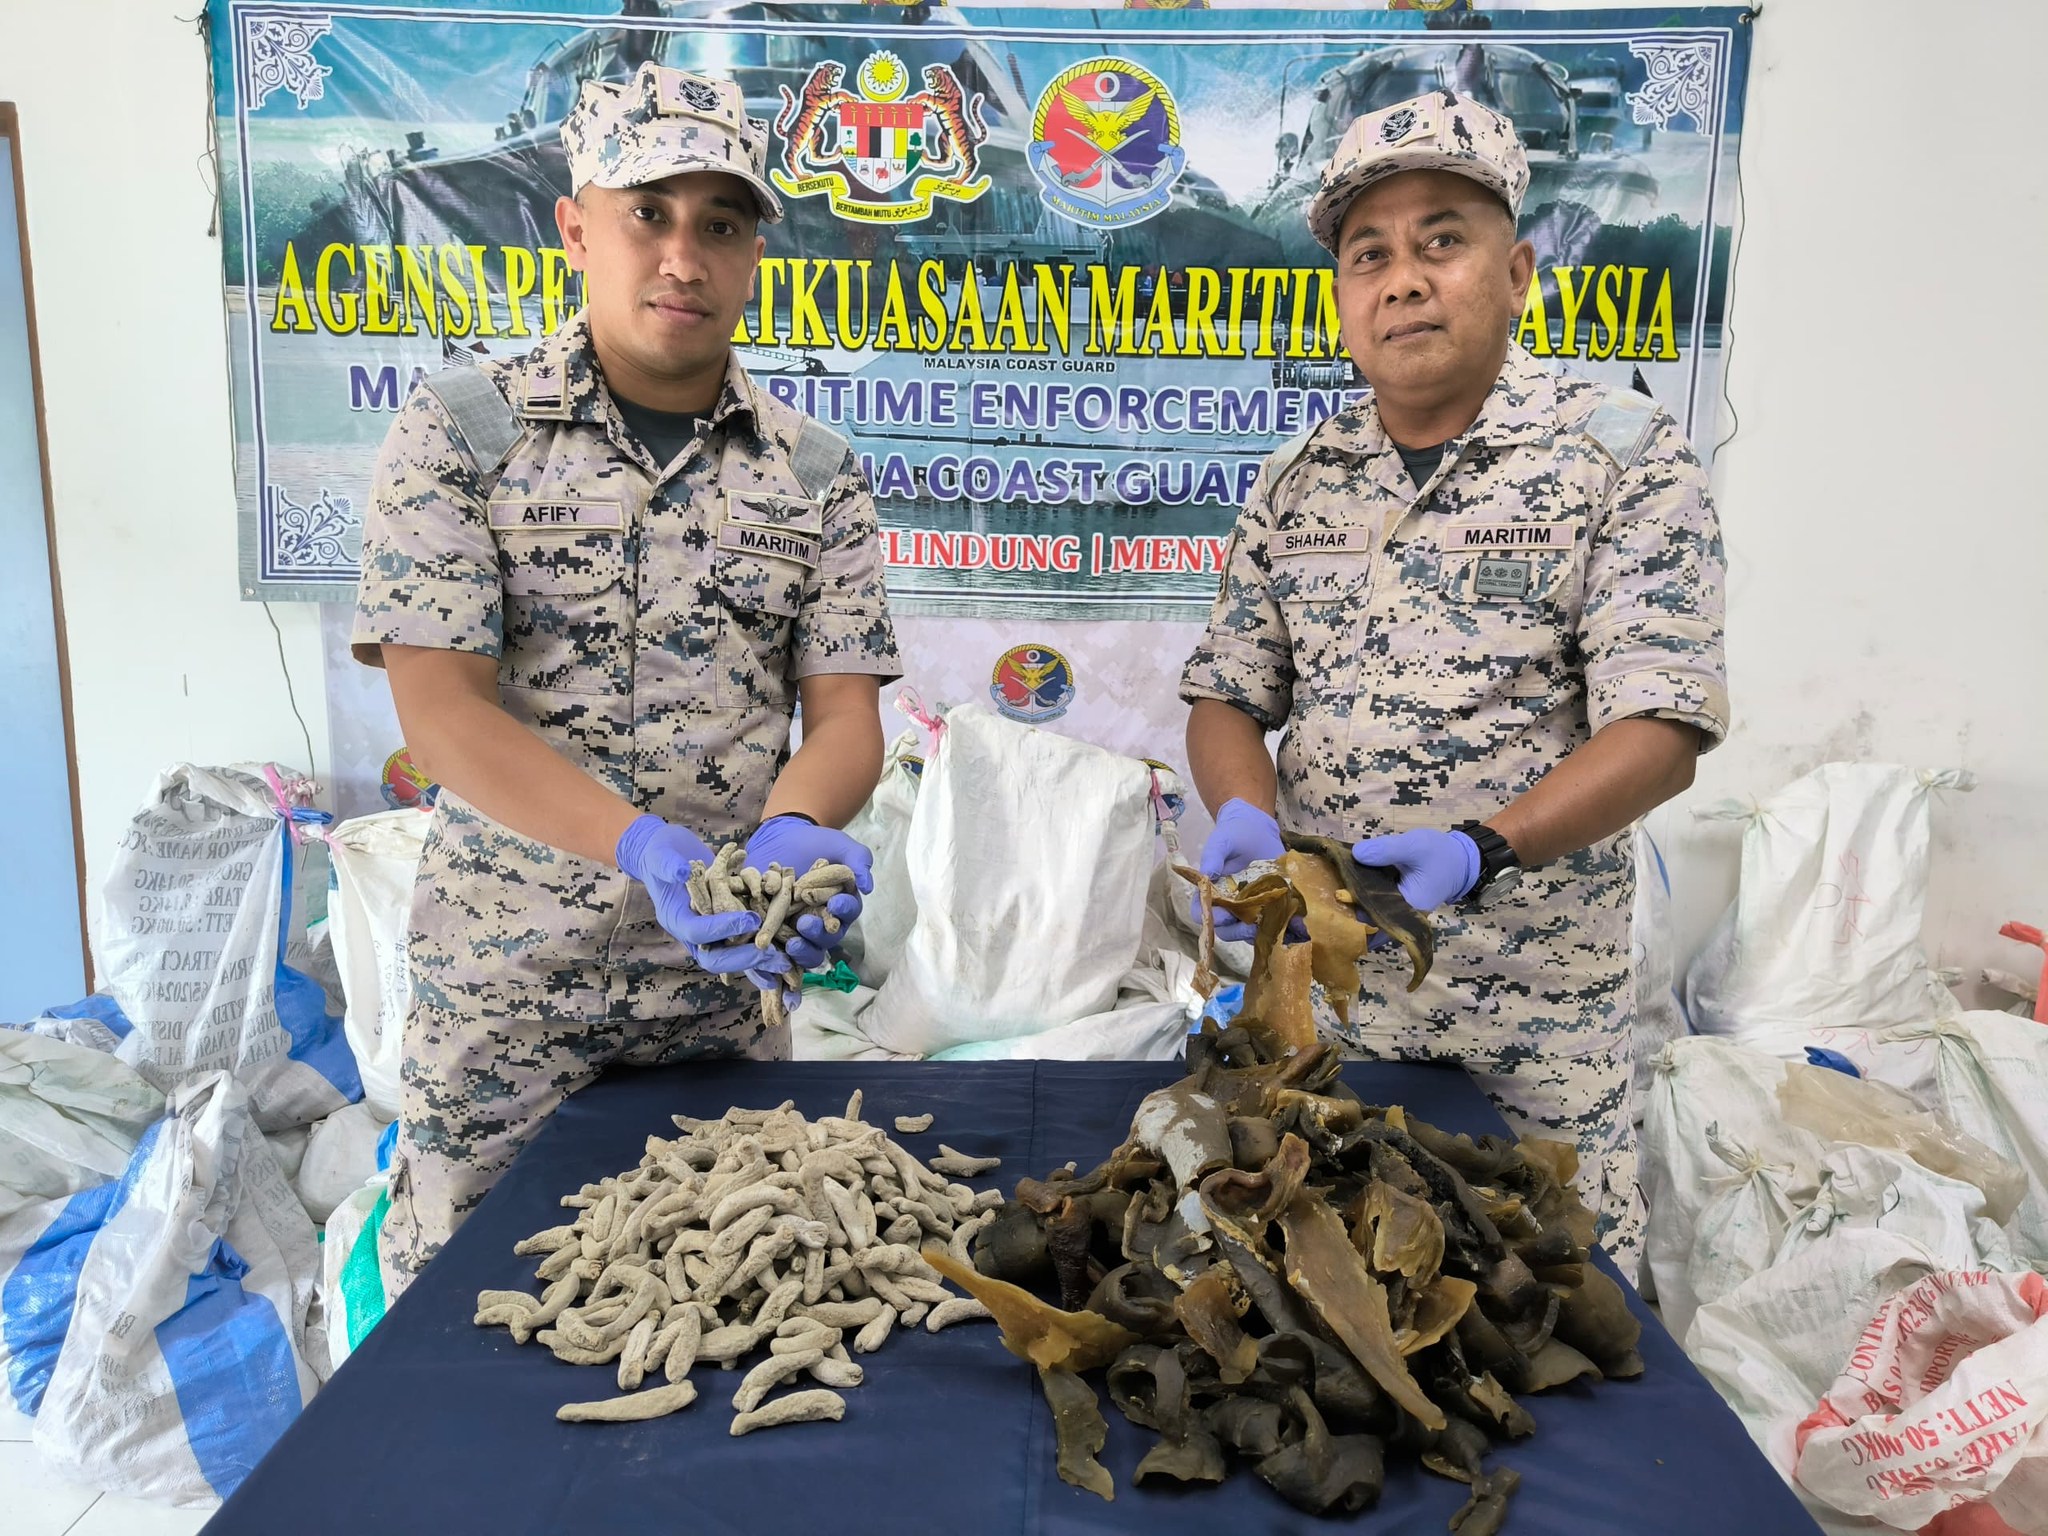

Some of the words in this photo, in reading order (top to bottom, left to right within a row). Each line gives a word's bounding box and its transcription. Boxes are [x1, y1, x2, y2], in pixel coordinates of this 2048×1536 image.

[797, 177, 834, 193] BERSEKUTU
[835, 201, 873, 218] BERTAMBAH
[874, 208, 892, 218] MUTU
[1052, 195, 1100, 222] MARITIM
[1103, 199, 1162, 222] MALAYSIA
[271, 240, 498, 337] AGENSI
[500, 245, 1077, 355] PETKUASAAN
[1516, 263, 1680, 360] AYSIA
[923, 357, 1001, 371] MALAYSIA
[1006, 359, 1059, 372] COAST
[1063, 360, 1116, 374] GUARD
[768, 377, 957, 424] RITIME
[973, 383, 1370, 432] ENFORCEMEN
[928, 456, 1104, 502] COAST
[1116, 460, 1261, 504] GUAR
[522, 506, 581, 523] AFIFY
[740, 530, 810, 559] MARITIM
[1285, 532, 1348, 549] SHAHAR
[1464, 527, 1551, 545] MARITIM
[879, 531, 1081, 572] LINDUNG
